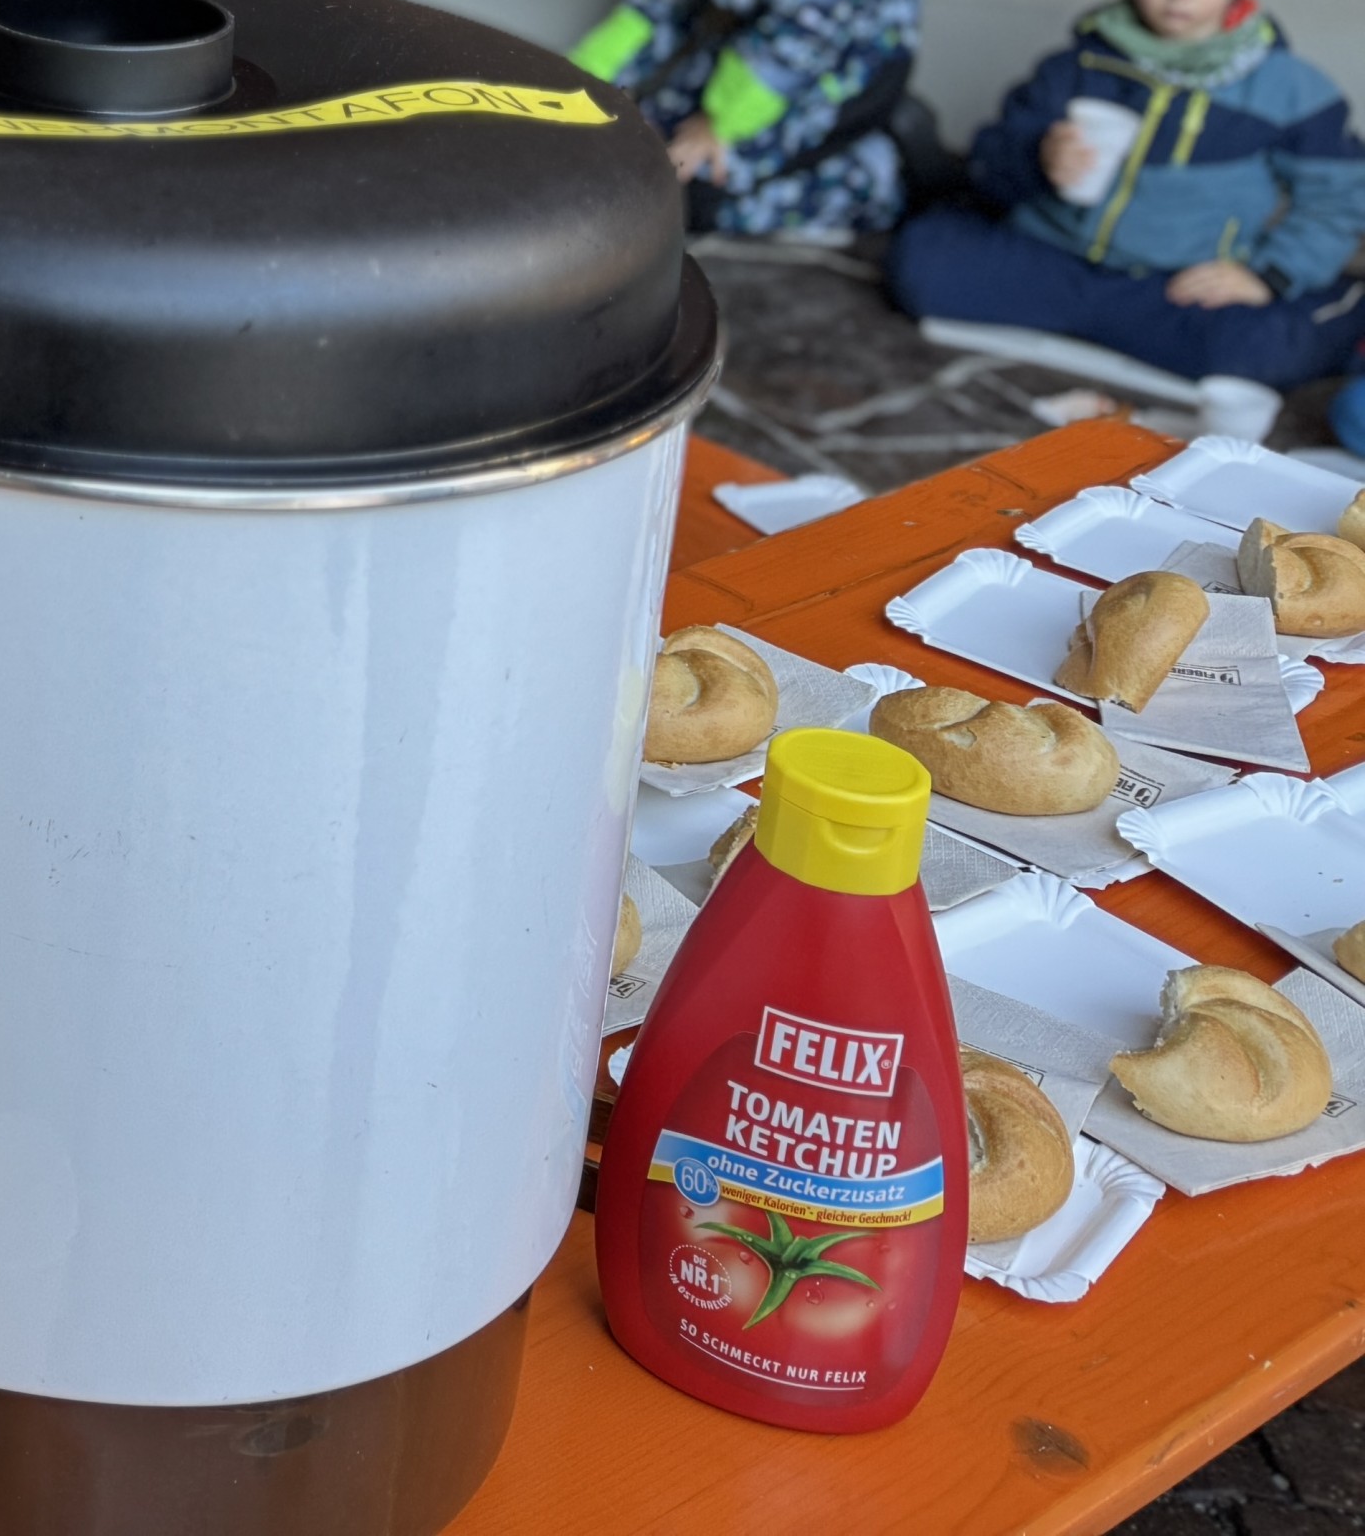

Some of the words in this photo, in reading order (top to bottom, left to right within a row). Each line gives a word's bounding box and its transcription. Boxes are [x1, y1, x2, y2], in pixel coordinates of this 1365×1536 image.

[769, 1021, 888, 1086] FELIX
[727, 1080, 902, 1150] TOMATEN
[725, 1113, 897, 1180] KETCHUP
[681, 1165, 718, 1195] 60%
[707, 1154, 759, 1181] ohne
[763, 1168, 907, 1203] Zuckerzusatz
[721, 1185, 763, 1205] weniger
[816, 1209, 857, 1222] gleicher
[858, 1210, 912, 1224] Geschmack!
[669, 1273, 680, 1285] IN
[693, 1254, 708, 1269] DIE
[680, 1318, 698, 1337] SO
[701, 1332, 782, 1374] SCHMECKT
[786, 1365, 819, 1382] NUR
[824, 1370, 867, 1383] FELIX
